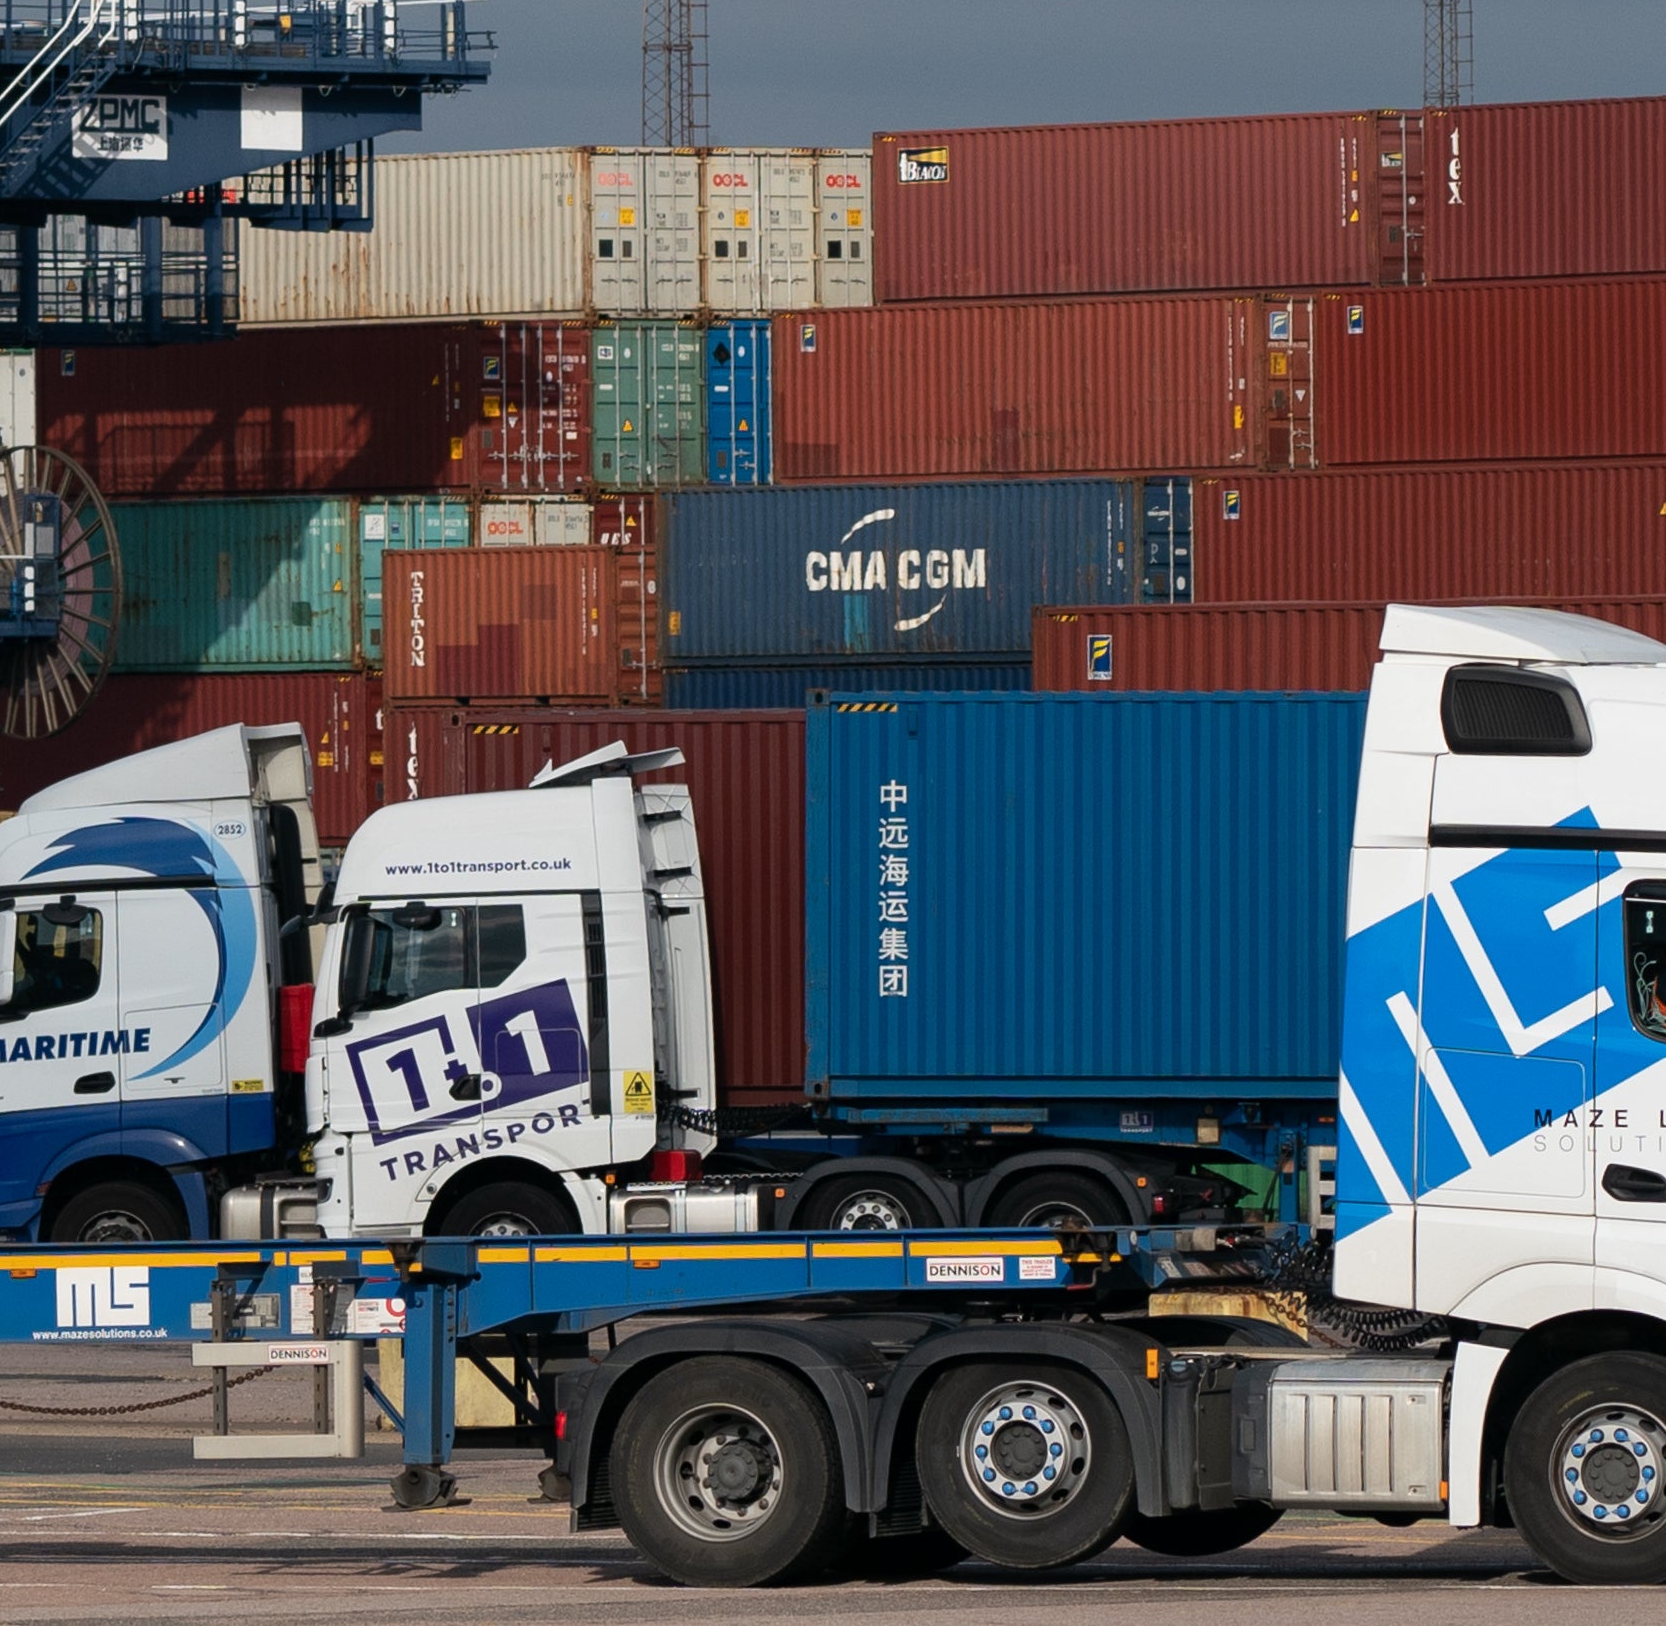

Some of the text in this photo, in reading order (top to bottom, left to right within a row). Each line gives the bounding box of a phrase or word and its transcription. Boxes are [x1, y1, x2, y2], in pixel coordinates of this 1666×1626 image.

[78, 97, 160, 134] ZPMC
[713, 173, 748, 187] OOCL
[826, 173, 861, 188] OOCL
[486, 521, 524, 535] OOCL
[806, 548, 987, 591] CMA CGM
[410, 571, 426, 667] TRITON
[218, 823, 243, 835] 2852
[385, 858, 572, 876] www.1to1transport.co.uk
[878, 780, 909, 997] 中远海运集团
[1534, 1108, 1630, 1129] MAZE
[379, 1098, 590, 1181] TRANSPOR
[930, 1265, 1001, 1276] DENNISON
[33, 1327, 168, 1340] www.mazesolutions.co.uk
[271, 1348, 326, 1360] DENNISON
